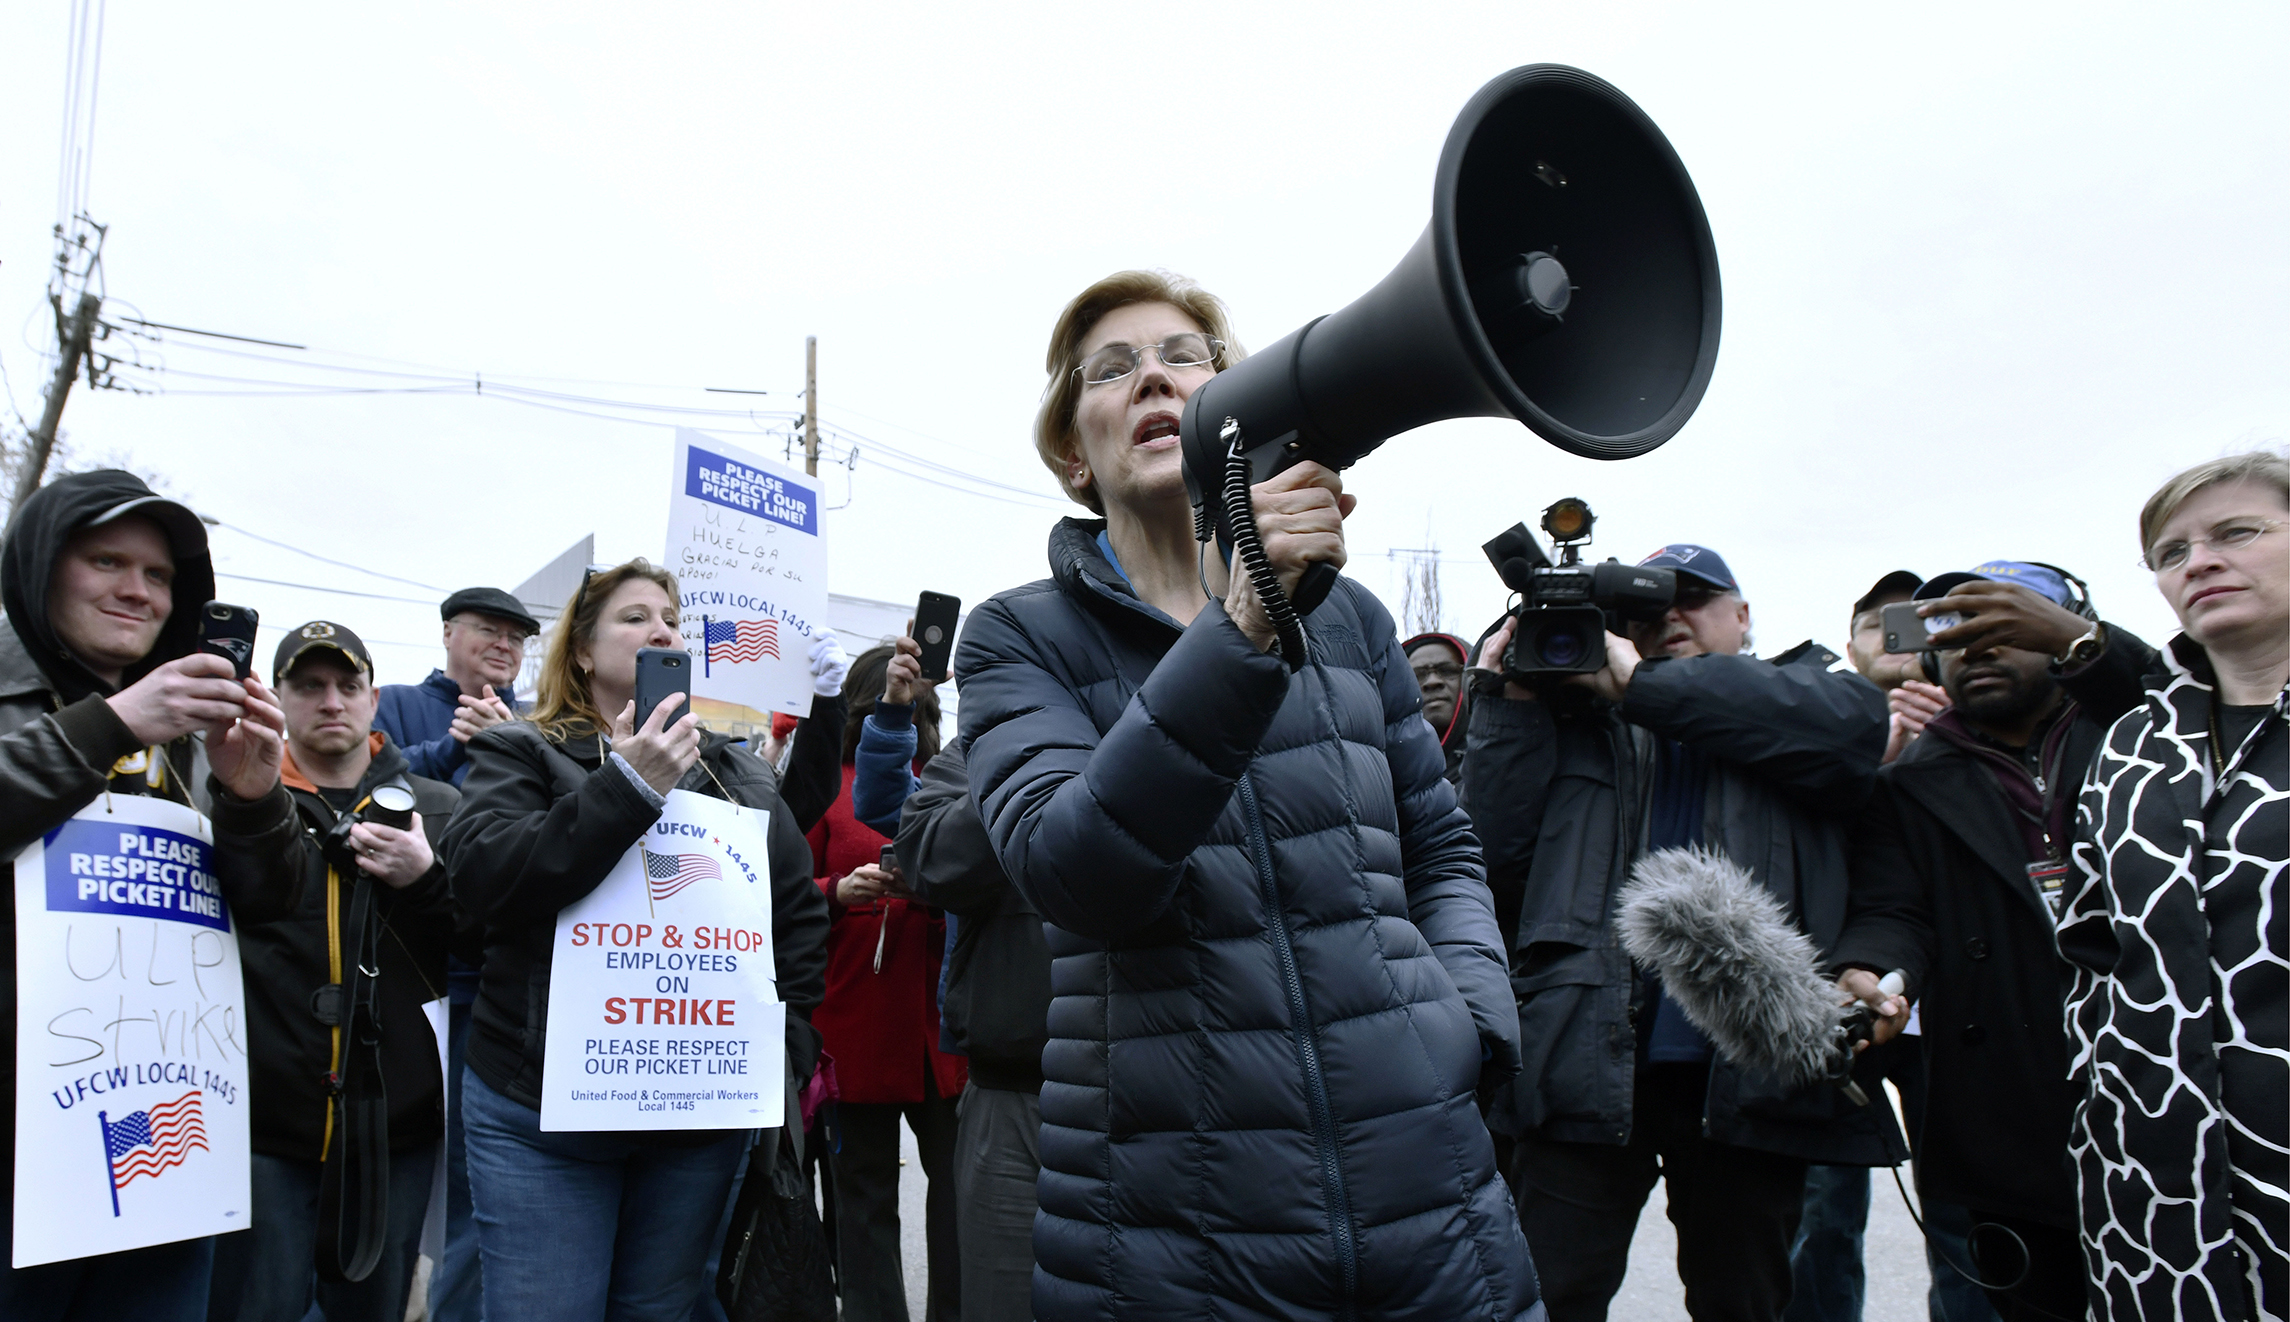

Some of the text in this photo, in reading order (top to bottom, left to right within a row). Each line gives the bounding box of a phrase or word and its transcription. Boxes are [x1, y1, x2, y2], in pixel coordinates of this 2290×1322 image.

[699, 466, 807, 515] RESPECT OUR
[726, 462, 784, 493] PLEASE
[702, 481, 804, 526] PICKET LINE!
[693, 526, 779, 560] HUELGA
[680, 591, 813, 637] UFCW LOCAL 1445
[119, 832, 201, 868] PLEASE
[656, 822, 758, 883] UFCW 1445
[70, 852, 222, 897] RESPECT OUR
[78, 878, 221, 919] PICKET LINE!
[571, 922, 763, 953] STOP & SHOP
[66, 922, 225, 1001] ULP
[606, 951, 738, 973] EMPLOYEES
[656, 976, 689, 994] ON
[603, 997, 736, 1026] STRIKE
[585, 1039, 750, 1056] PLEASE RESPECT
[585, 1058, 748, 1075] OUR PICKET LINE
[52, 1062, 237, 1110] UFCW LOCAL 1445
[571, 1090, 759, 1101] United Food & Commercial Workers
[638, 1101, 695, 1111] Local 1445
